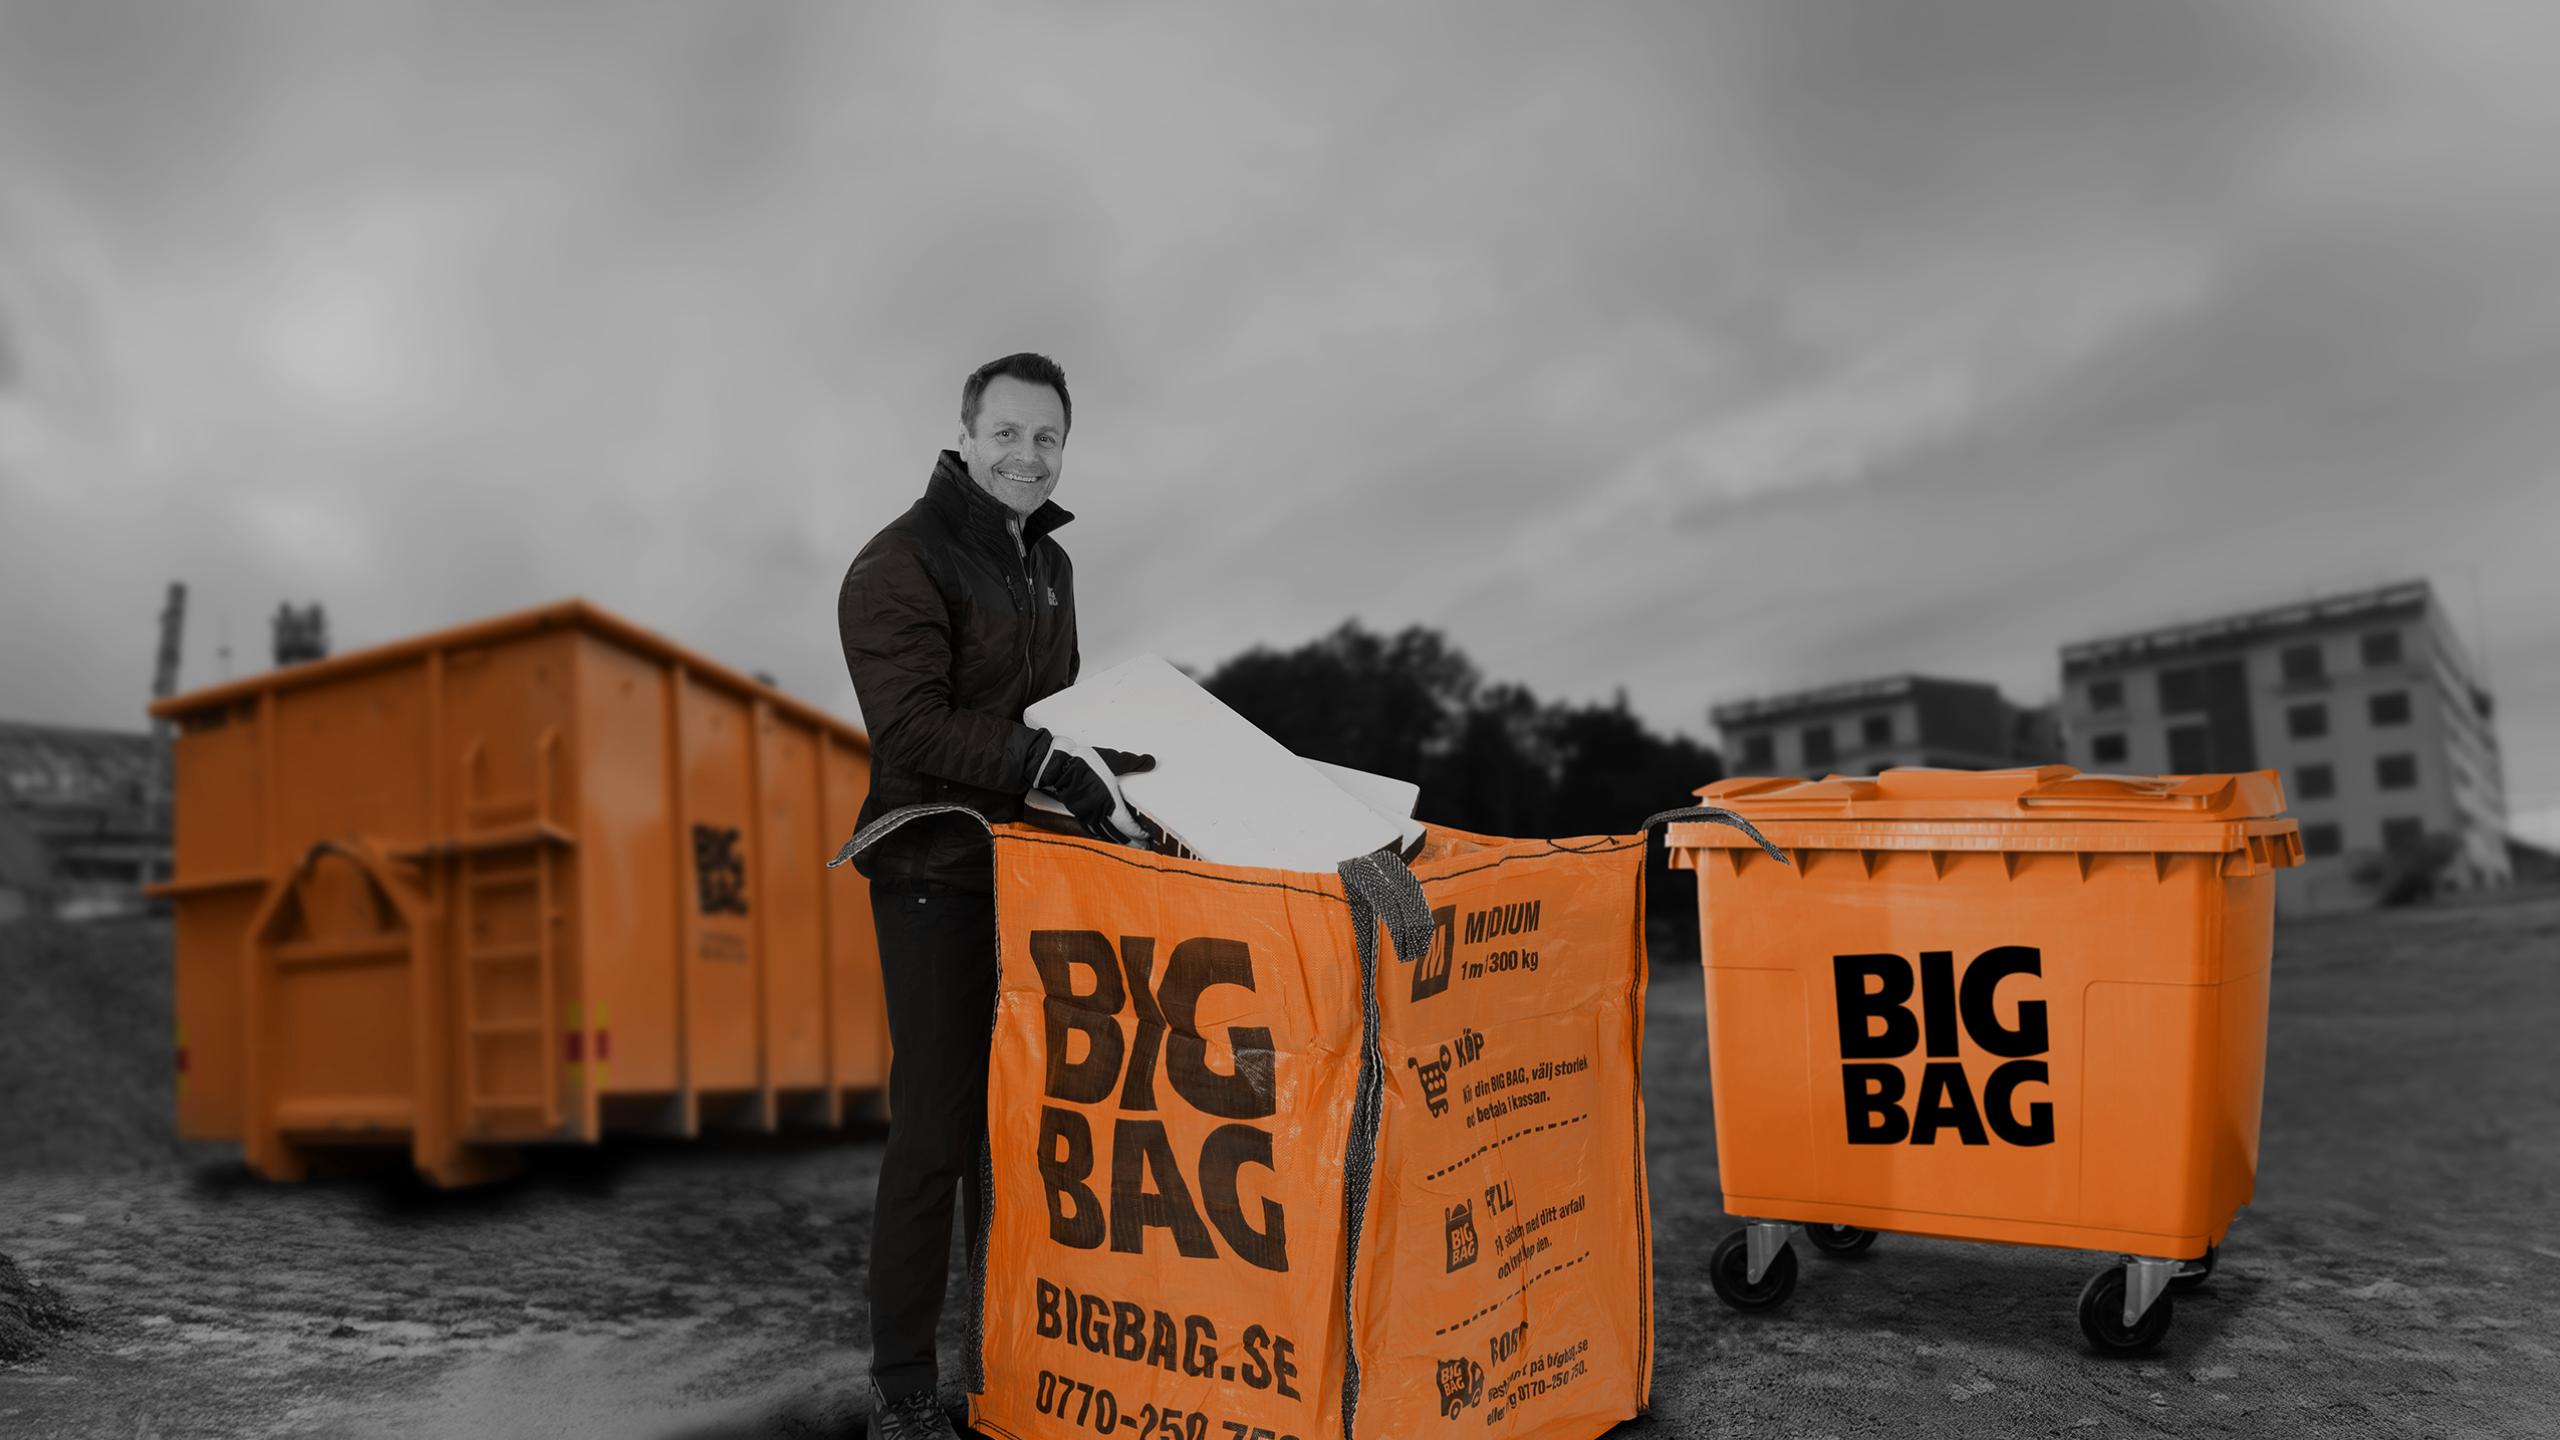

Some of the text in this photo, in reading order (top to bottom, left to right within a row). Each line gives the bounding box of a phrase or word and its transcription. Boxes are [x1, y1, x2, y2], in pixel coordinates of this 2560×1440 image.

[1464, 900, 1541, 945] MDIUM
[1522, 948, 1538, 972] kg
[1833, 945, 2049, 1059] BIG
[1029, 930, 1277, 1119] BIG
[1454, 1028, 1484, 1068] KÖP
[1475, 1078, 1490, 1098] din
[1490, 1073, 1505, 1093] BIG
[1506, 1067, 1530, 1088] BAG,
[1532, 1062, 1553, 1081] välj
[1476, 1100, 1508, 1123] betala
[1512, 1090, 1551, 1111] kassan.
[1841, 1060, 2055, 1147] BAG
[1036, 1104, 1289, 1272] BAG
[1540, 1206, 1557, 1227] ditt
[1559, 1194, 1586, 1219] avfall
[1451, 1222, 1474, 1250] BIG
[1452, 1240, 1475, 1266] BAG
[1036, 1277, 1302, 1403] BIGBAG.SE
[1441, 1361, 1462, 1384] BIG
[1530, 1355, 1545, 1378] på
[1443, 1376, 1465, 1397] BAG
